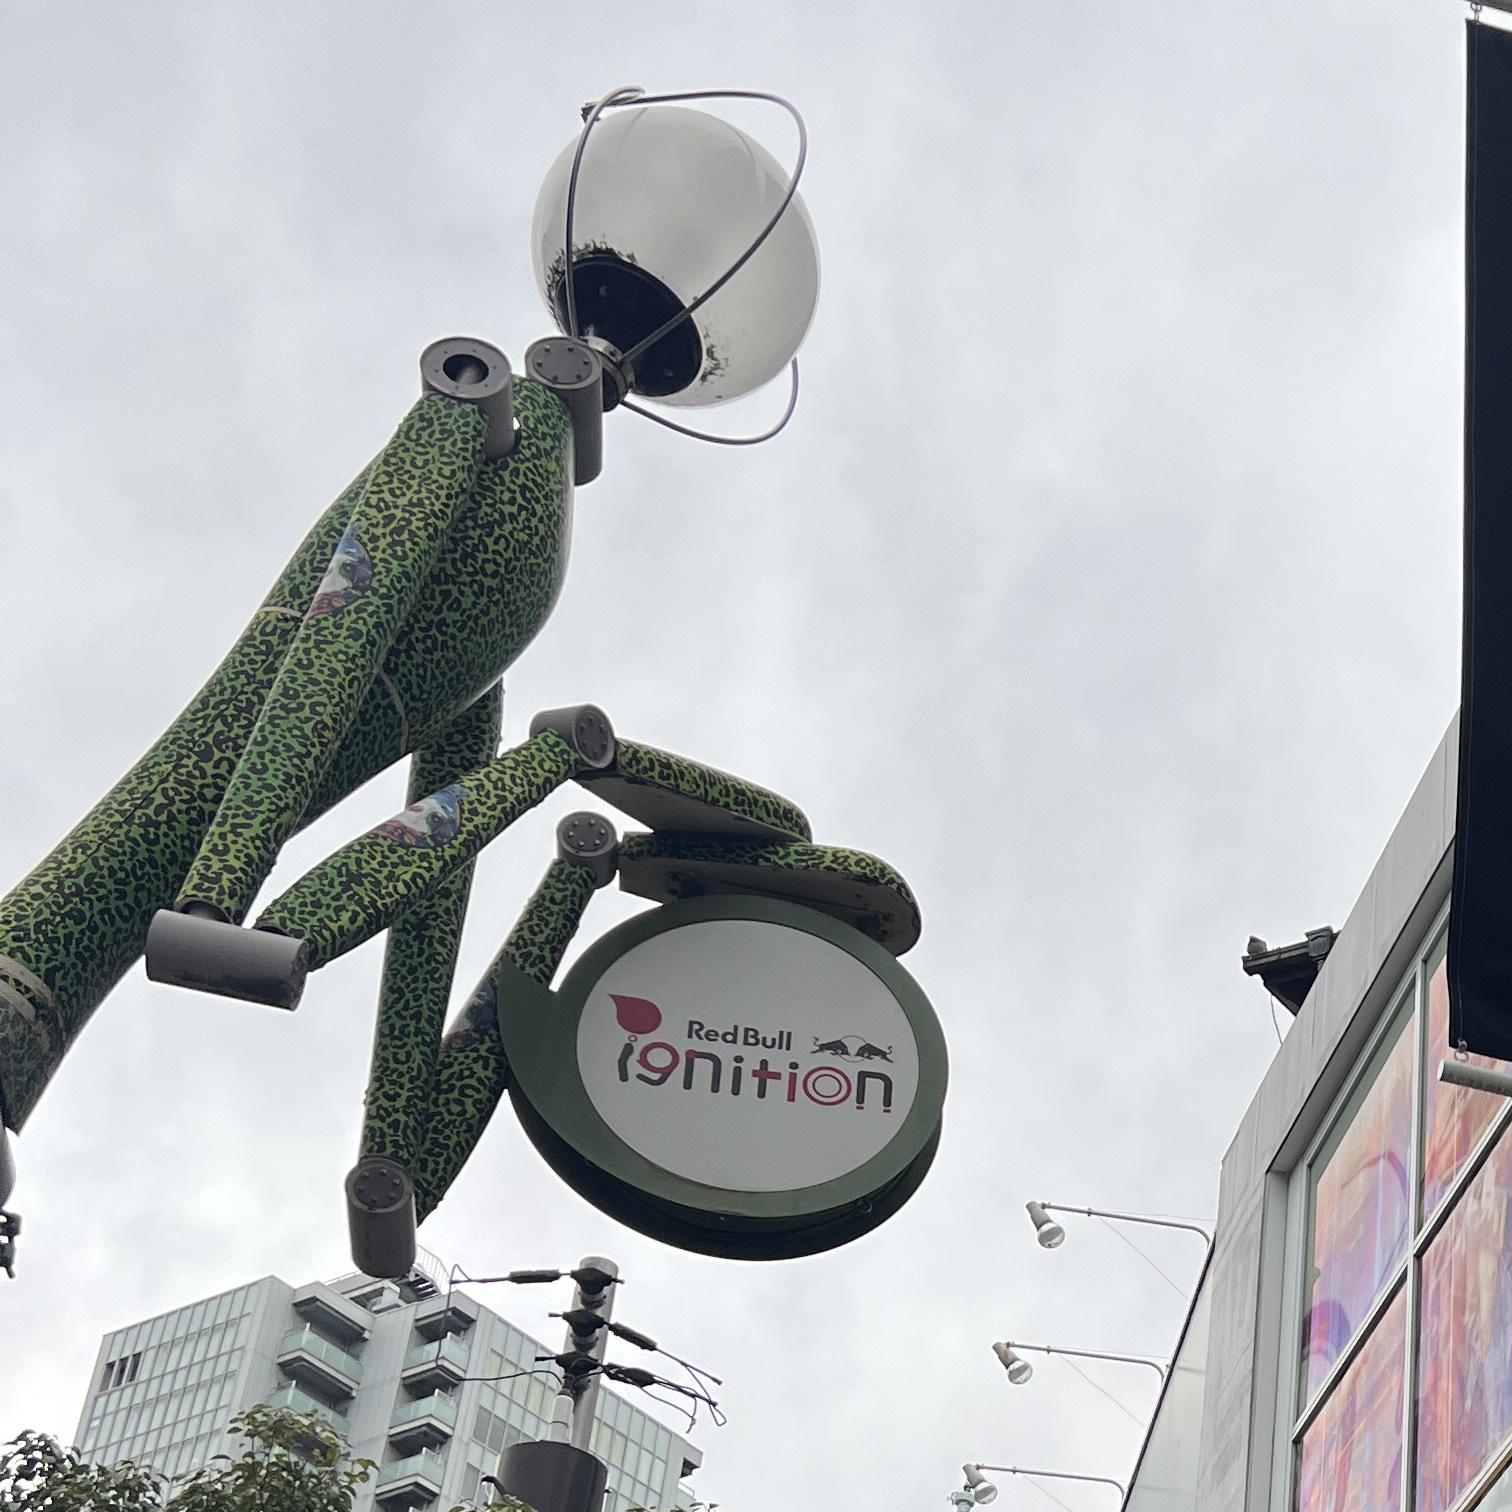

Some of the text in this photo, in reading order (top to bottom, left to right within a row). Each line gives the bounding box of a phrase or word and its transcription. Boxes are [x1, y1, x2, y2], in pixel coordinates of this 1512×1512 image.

[687, 1020, 793, 1052] Red Bull
[617, 1034, 895, 1114] ignition
